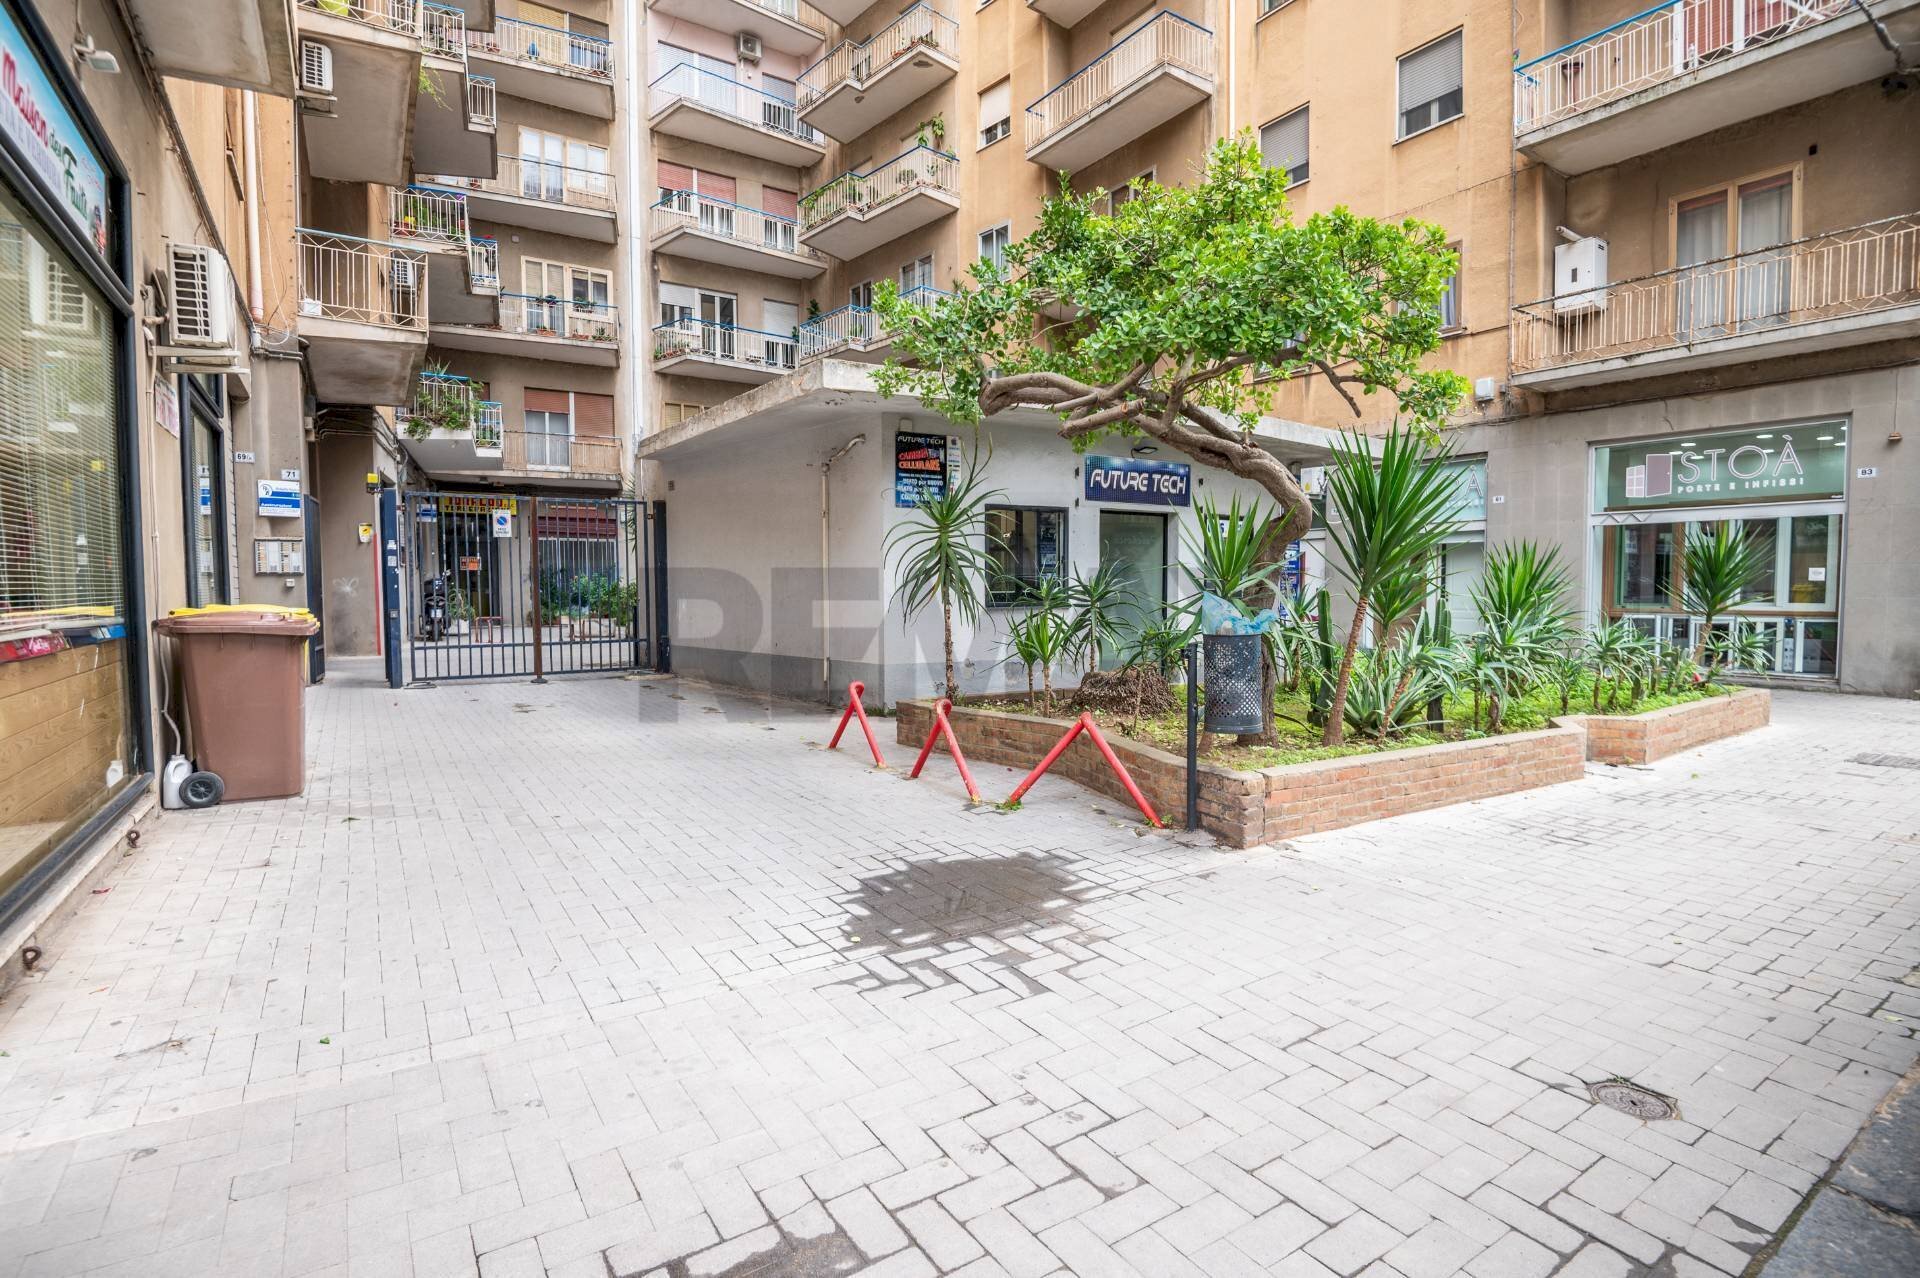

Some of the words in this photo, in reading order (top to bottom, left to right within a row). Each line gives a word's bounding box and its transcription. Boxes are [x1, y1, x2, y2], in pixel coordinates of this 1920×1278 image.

[2, 49, 49, 148] Maison
[897, 435, 925, 443] FUTURE
[898, 459, 941, 471] CELLULARE
[1677, 434, 1804, 484] STOÀ
[286, 470, 296, 478] 71
[1090, 468, 1148, 492] FUTURE
[1152, 473, 1187, 495] TECH
[1677, 483, 1721, 494] PORTE
[1728, 482, 1737, 491] E
[1745, 477, 1804, 489] INFISSI
